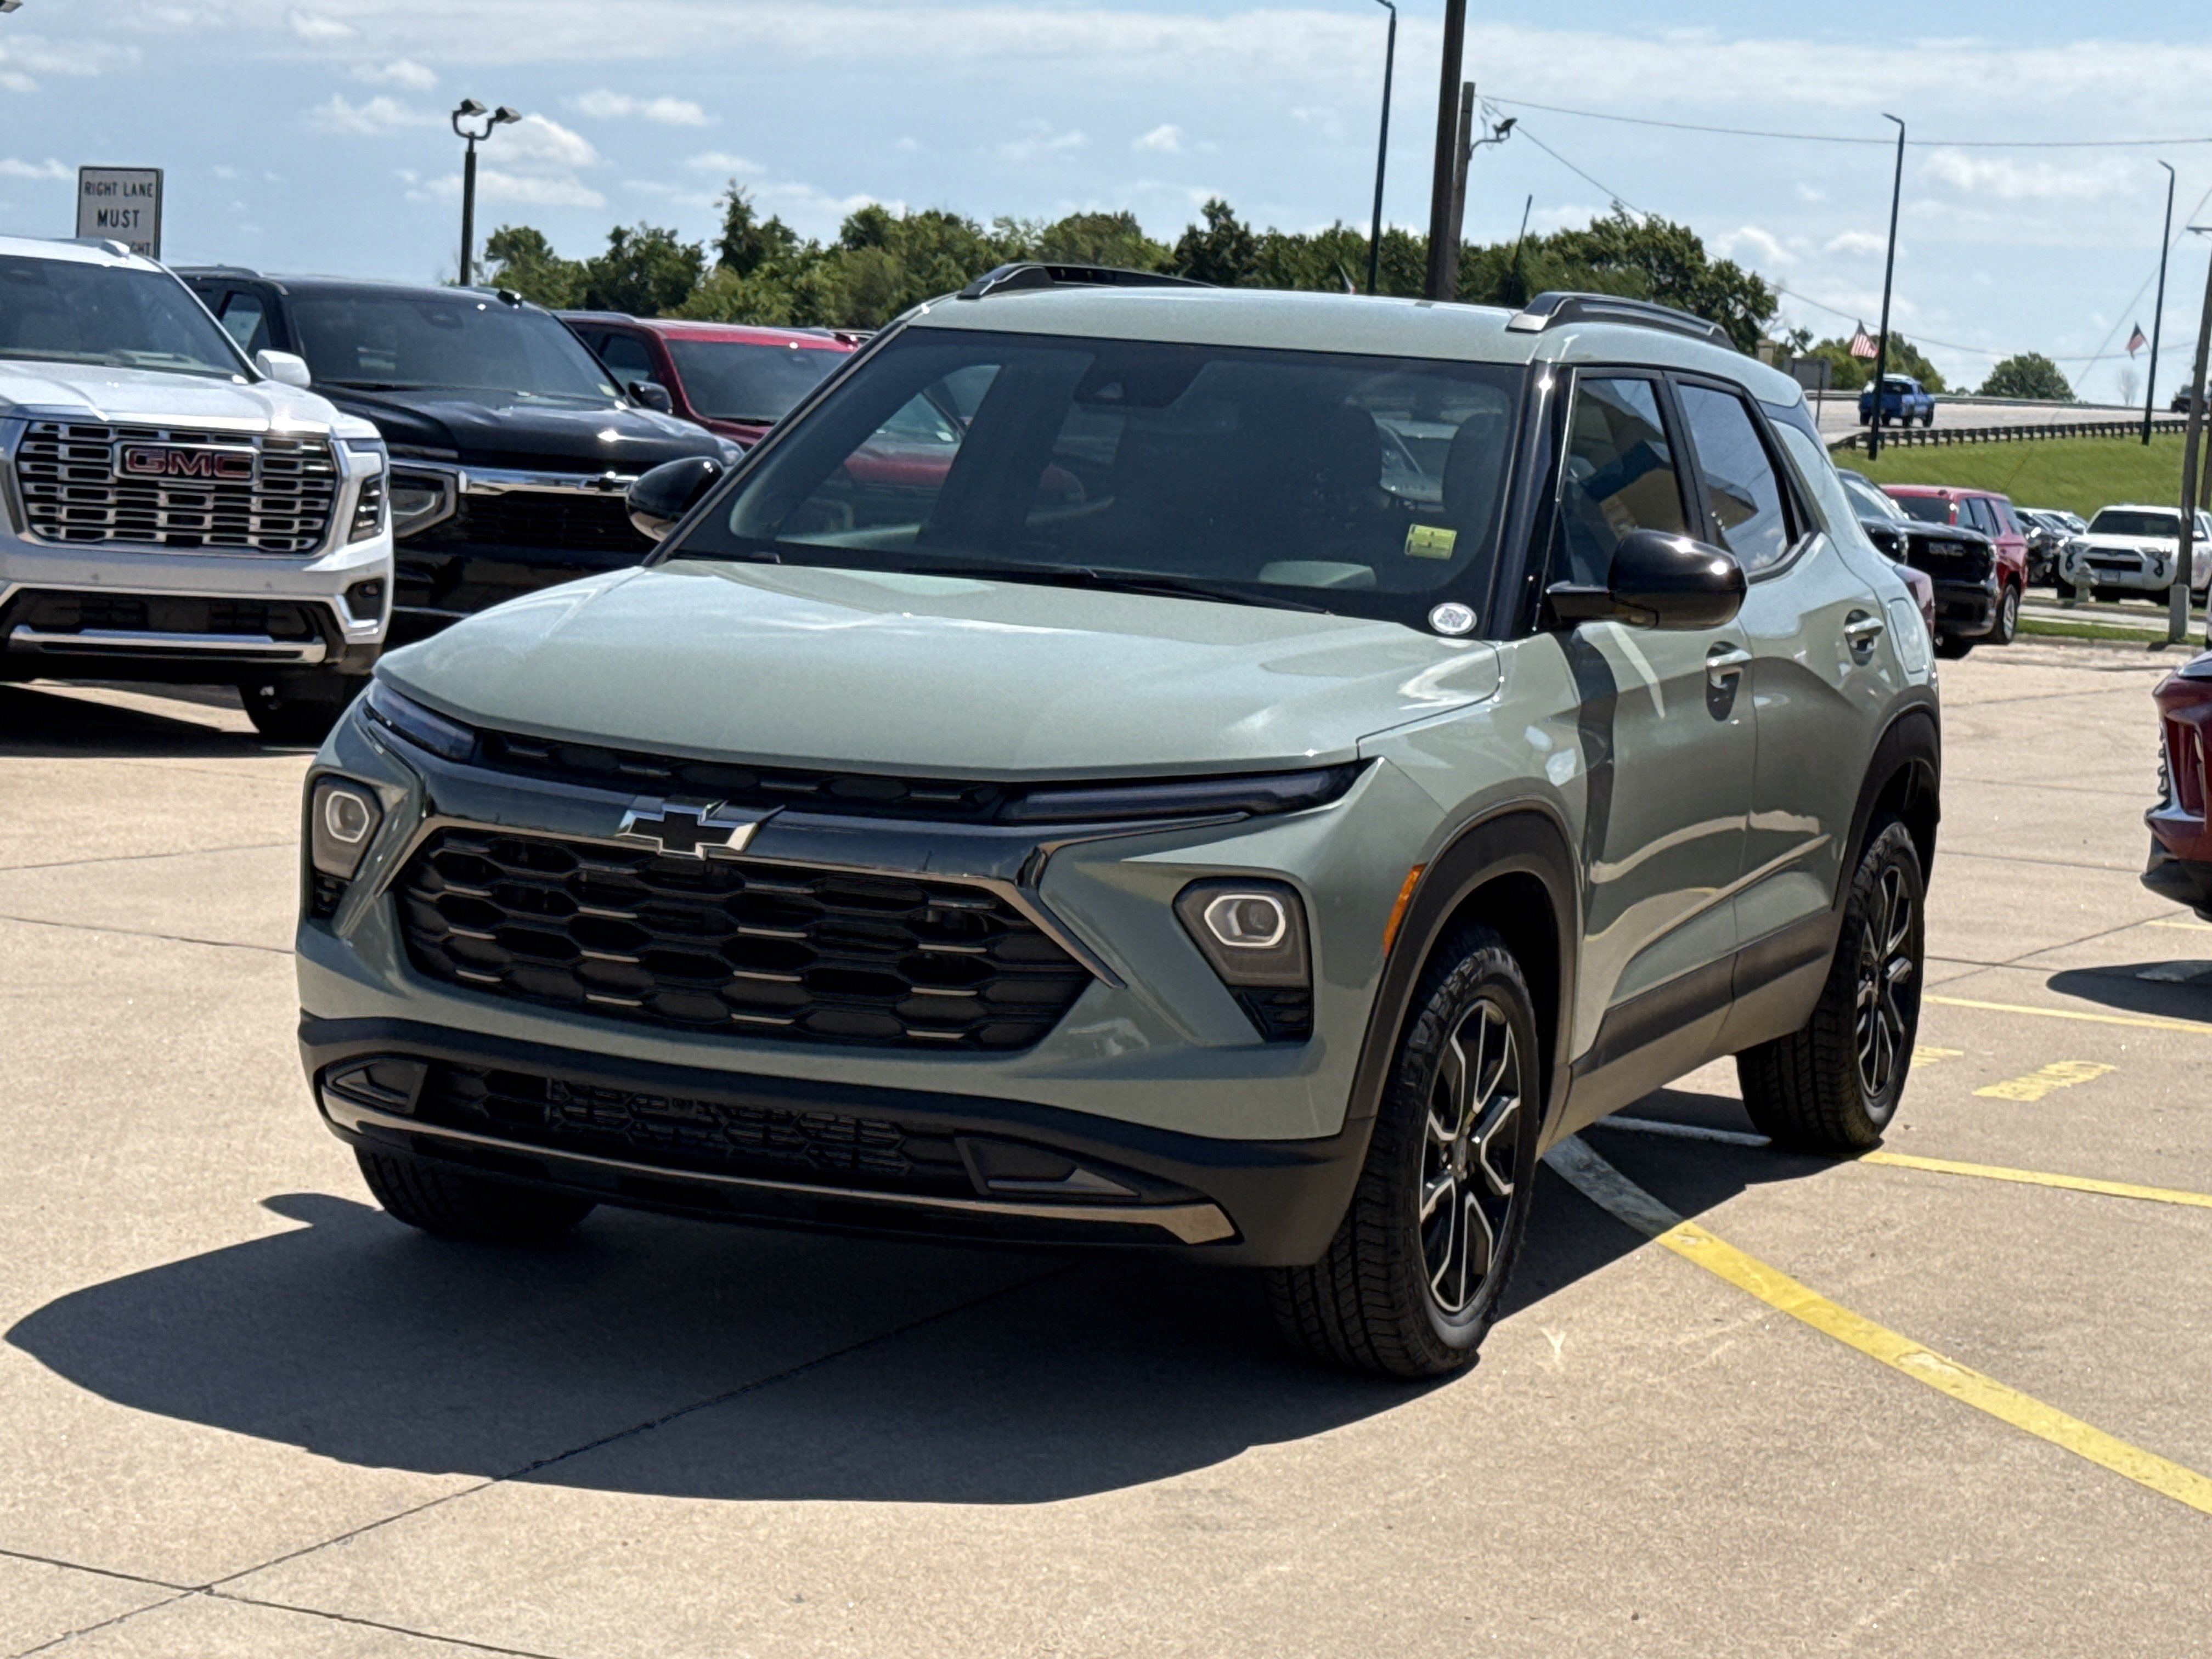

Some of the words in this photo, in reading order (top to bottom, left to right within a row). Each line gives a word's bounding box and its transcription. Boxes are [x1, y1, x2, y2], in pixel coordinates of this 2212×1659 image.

[84, 182, 118, 196] RIGHT
[123, 182, 153, 198] LANE
[97, 208, 140, 229] MUST
[129, 241, 151, 256] GHT
[126, 448, 252, 479] GMC
